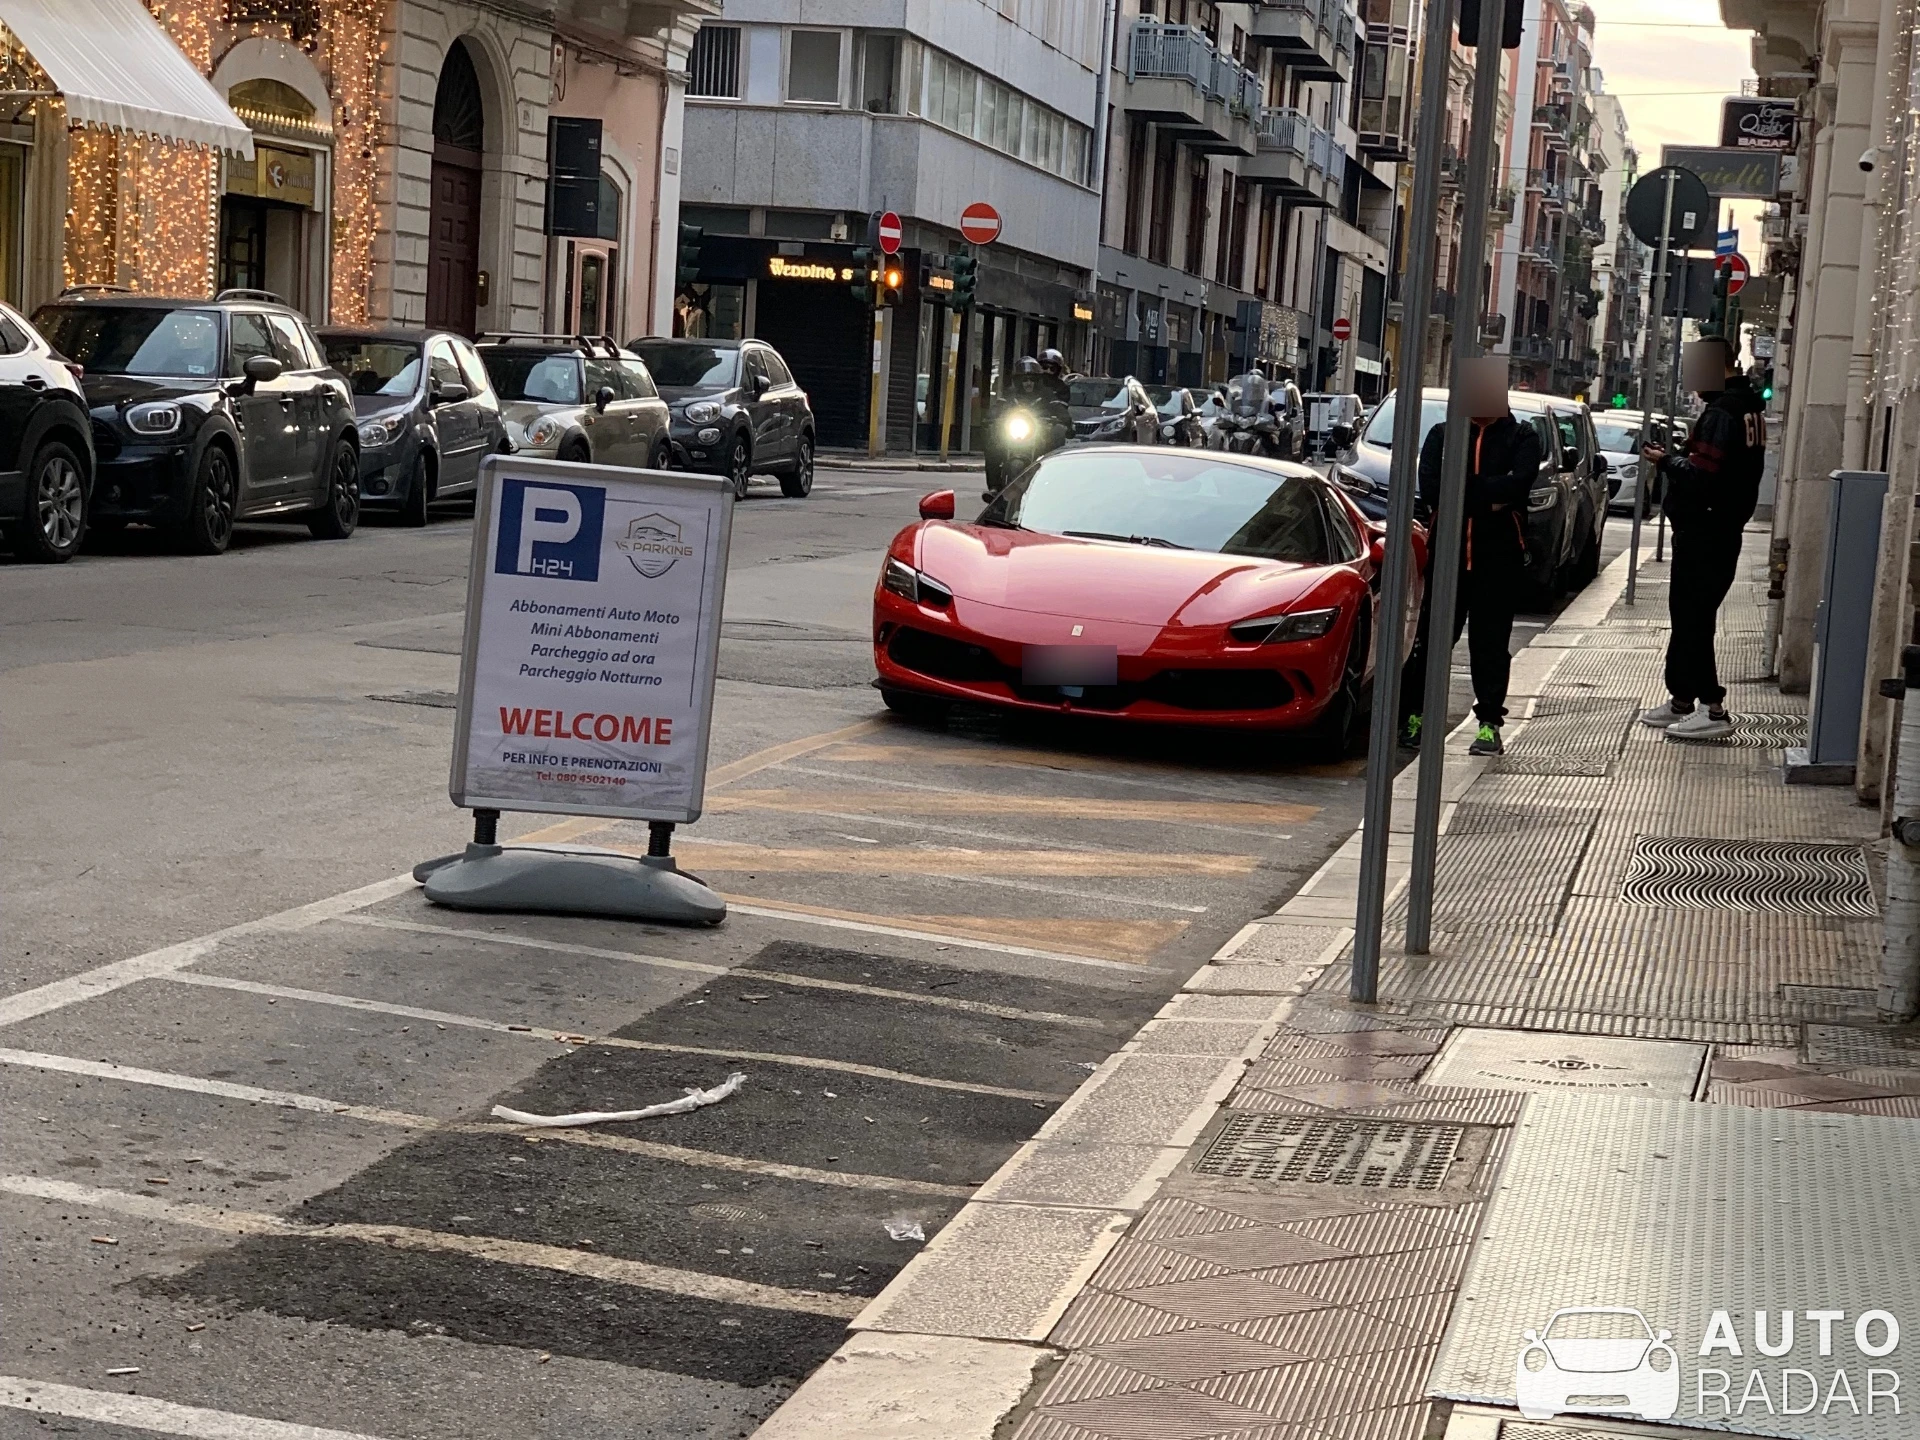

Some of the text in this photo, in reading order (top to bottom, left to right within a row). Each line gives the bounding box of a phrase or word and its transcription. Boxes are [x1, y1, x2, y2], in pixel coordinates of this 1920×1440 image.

[1739, 113, 1791, 137] Quality
[517, 487, 582, 573] P
[633, 542, 693, 557] PARKING
[532, 558, 573, 577] H24
[509, 599, 680, 625] Abbonamenti Auto Moto
[530, 622, 660, 644] Mini Abbonamenti
[530, 643, 656, 665] Parcheggio ad ora
[519, 663, 663, 686] Parcheggio Notturno
[499, 706, 673, 745] WELCOME
[502, 752, 662, 774] PER INFO E PRENOTAZIONI
[536, 771, 626, 786] Tel. 080 4502140
